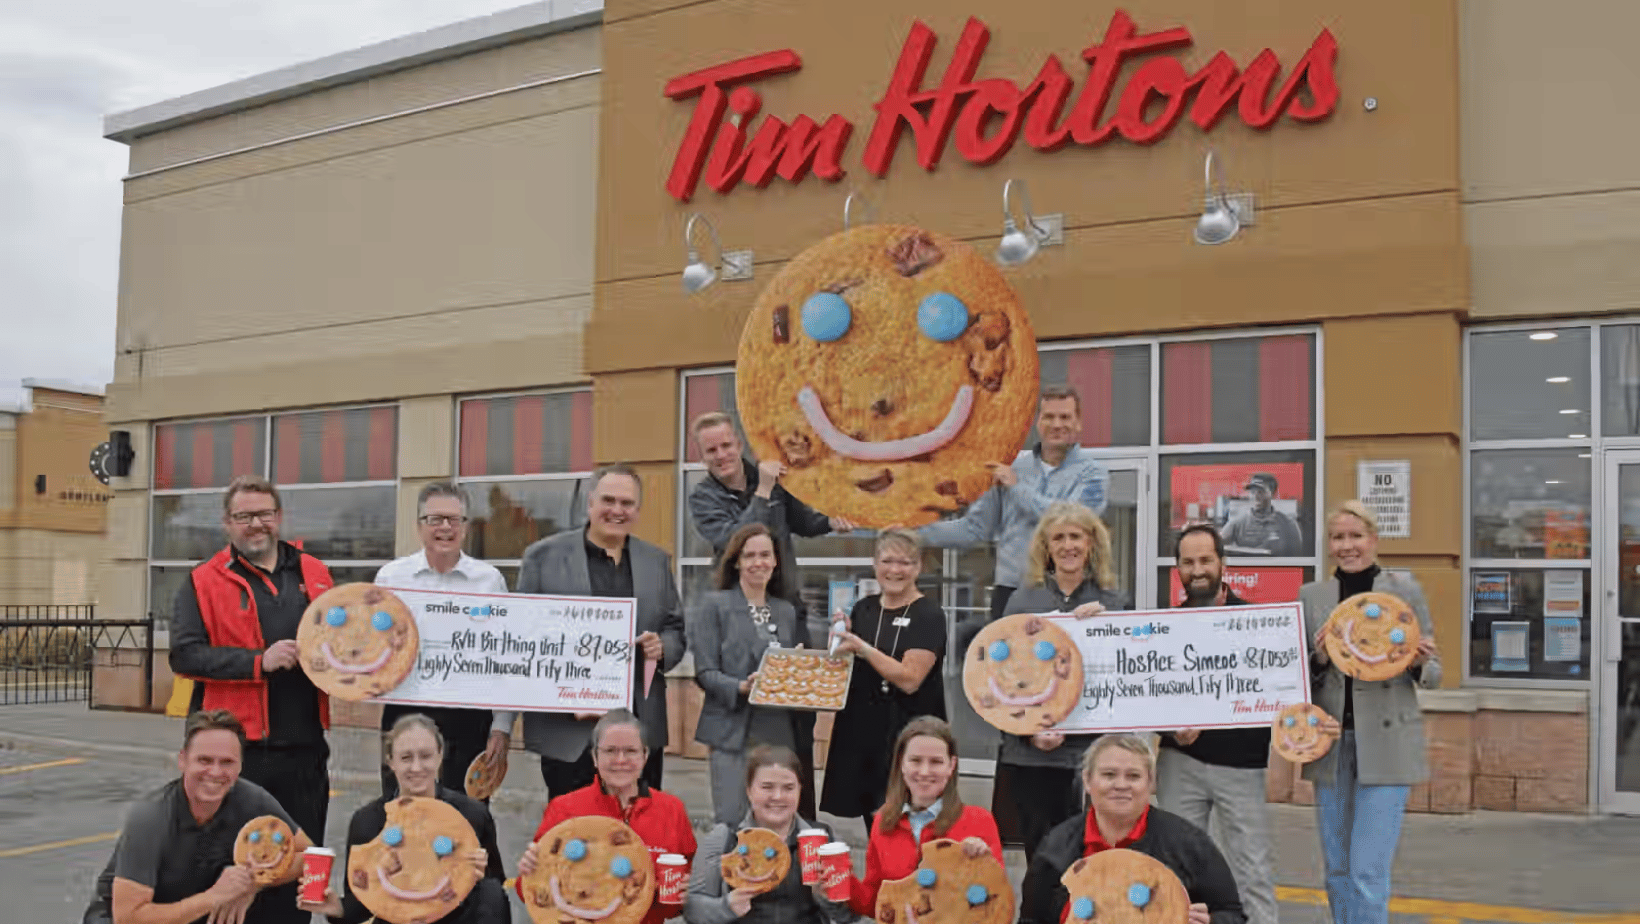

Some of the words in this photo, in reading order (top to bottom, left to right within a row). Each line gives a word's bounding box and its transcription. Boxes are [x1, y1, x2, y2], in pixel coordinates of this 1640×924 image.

[664, 49, 854, 204] Tim
[862, 8, 1341, 179] Hortons
[1374, 474, 1392, 486] NO
[425, 601, 460, 614] smile
[1086, 623, 1121, 637] smile
